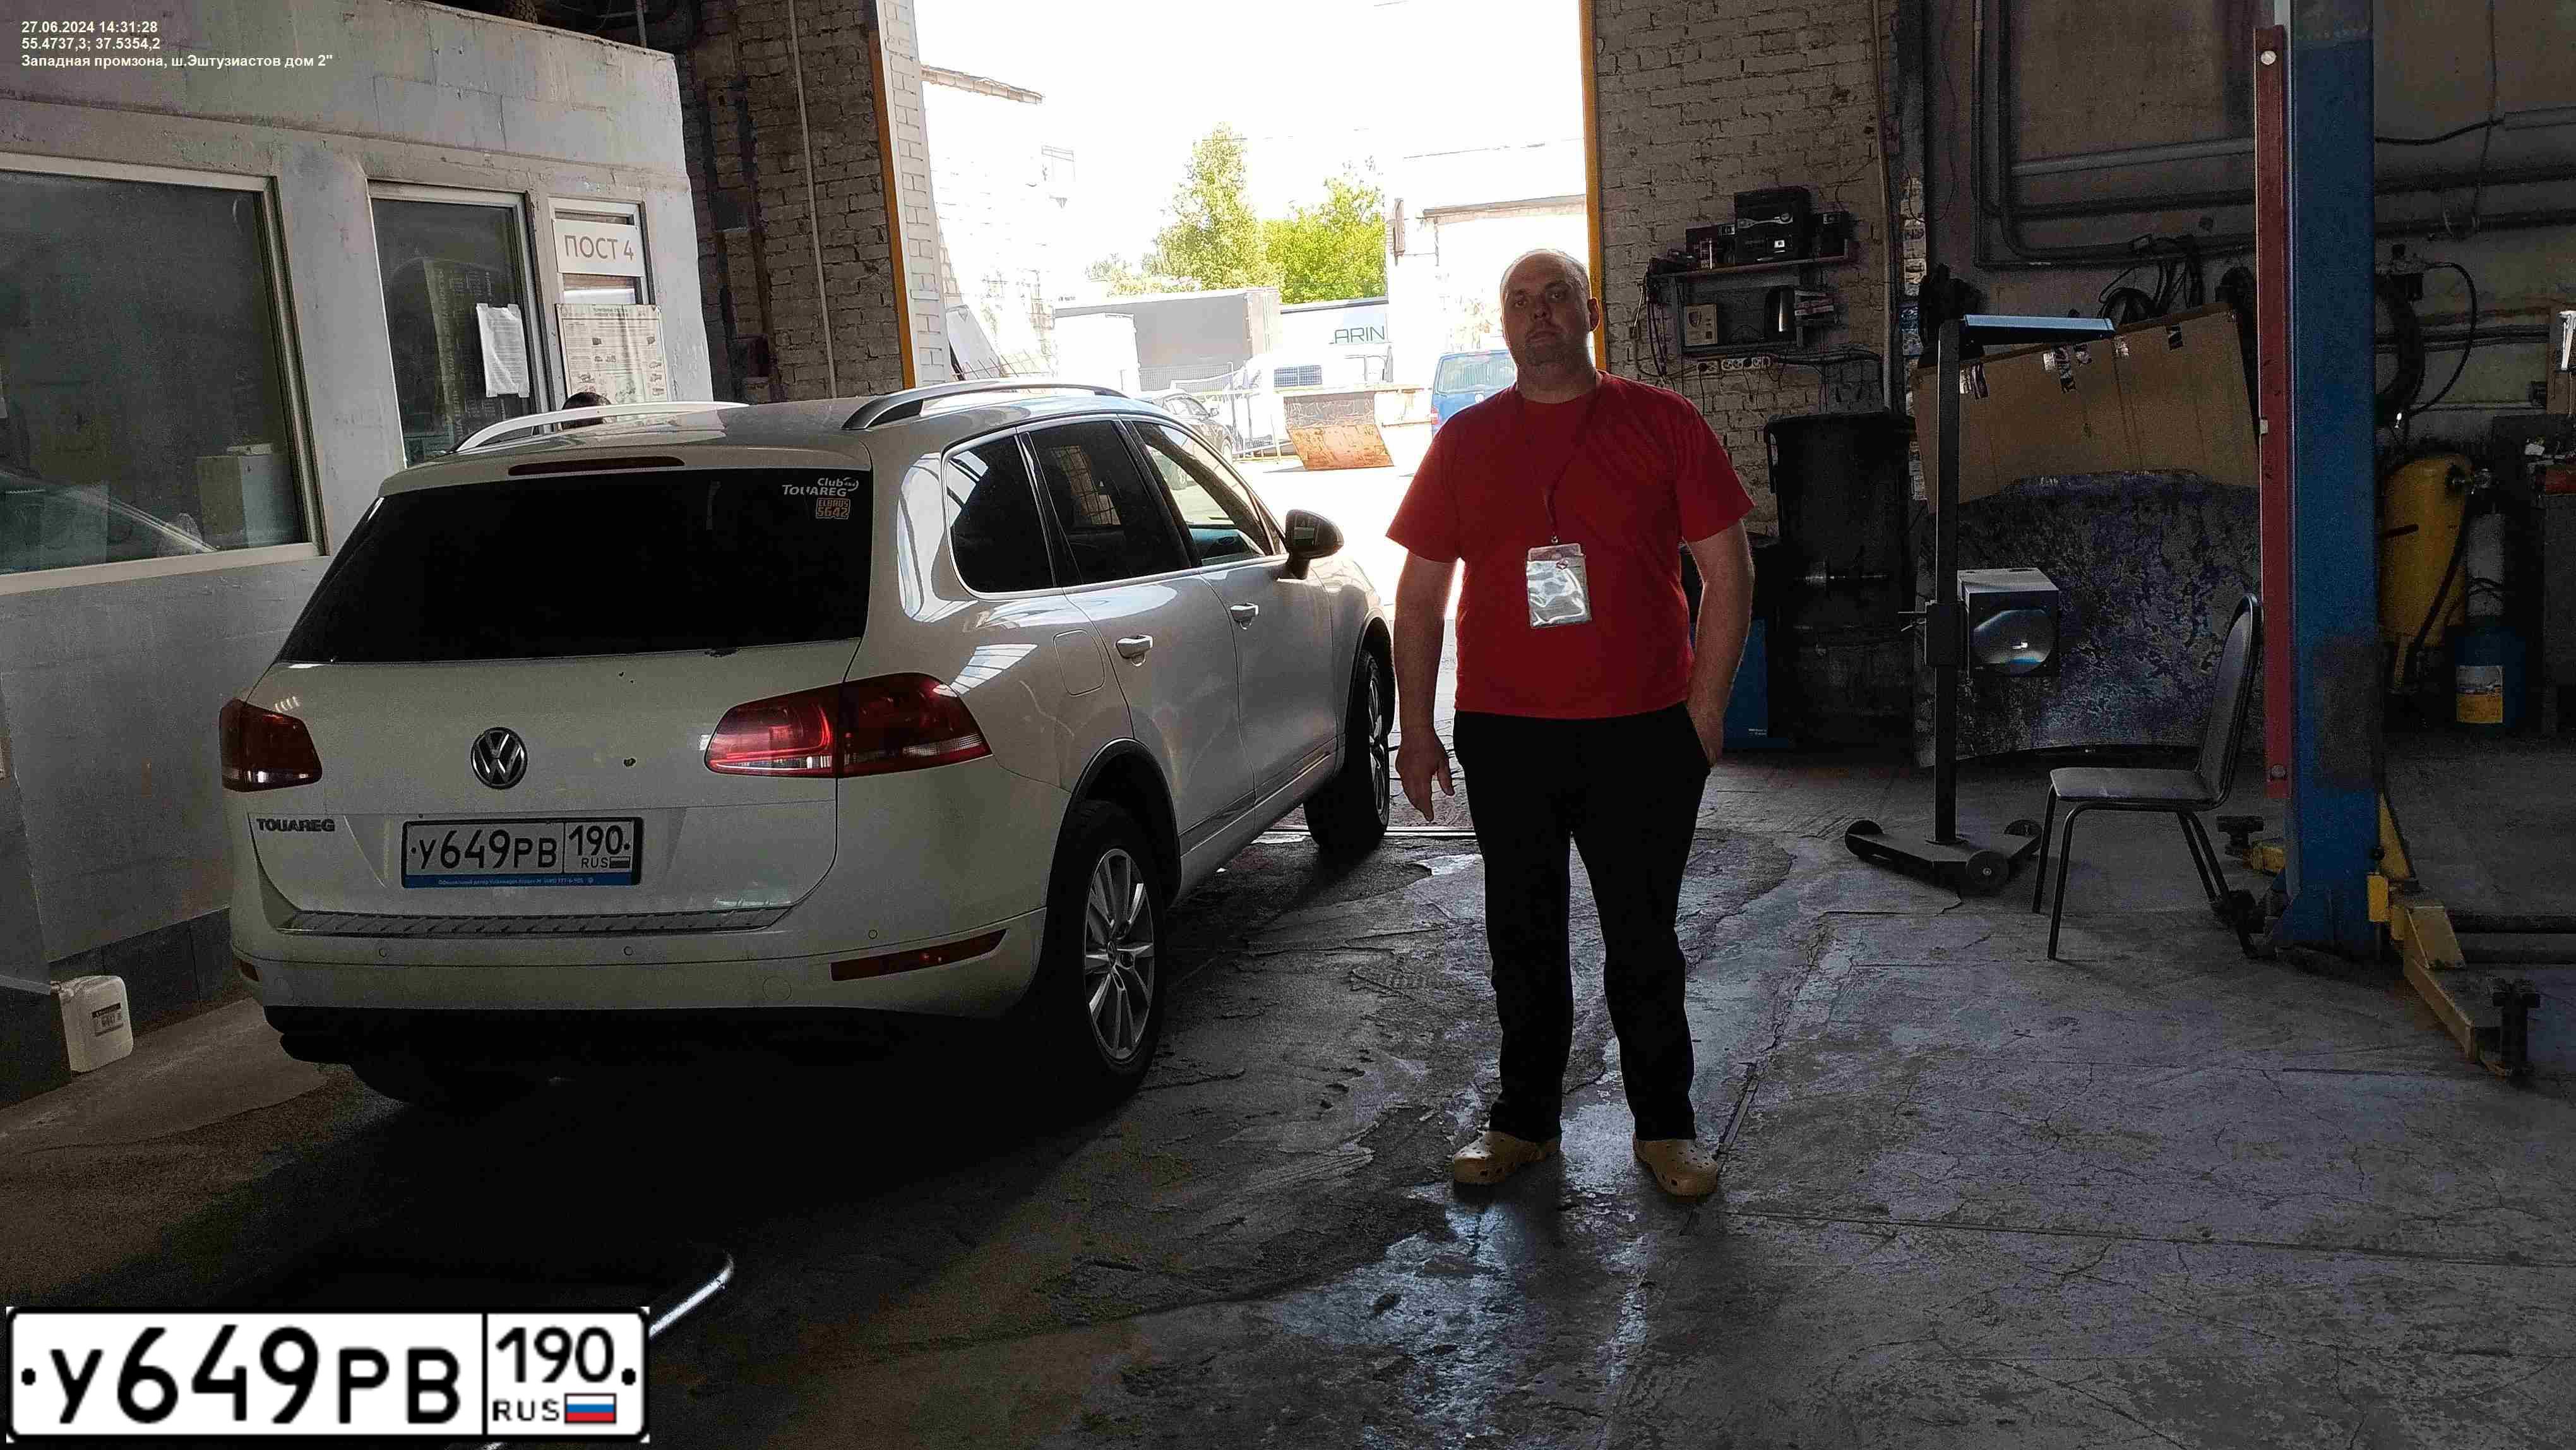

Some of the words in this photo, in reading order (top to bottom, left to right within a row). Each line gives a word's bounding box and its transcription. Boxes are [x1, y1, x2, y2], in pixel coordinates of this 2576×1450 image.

[564, 234, 618, 260] ПОСТ
[623, 239, 635, 261] 4
[817, 477, 844, 487] Club
[256, 818, 335, 832] TOUAREG
[568, 824, 624, 856] 190
[580, 856, 609, 869] RUS
